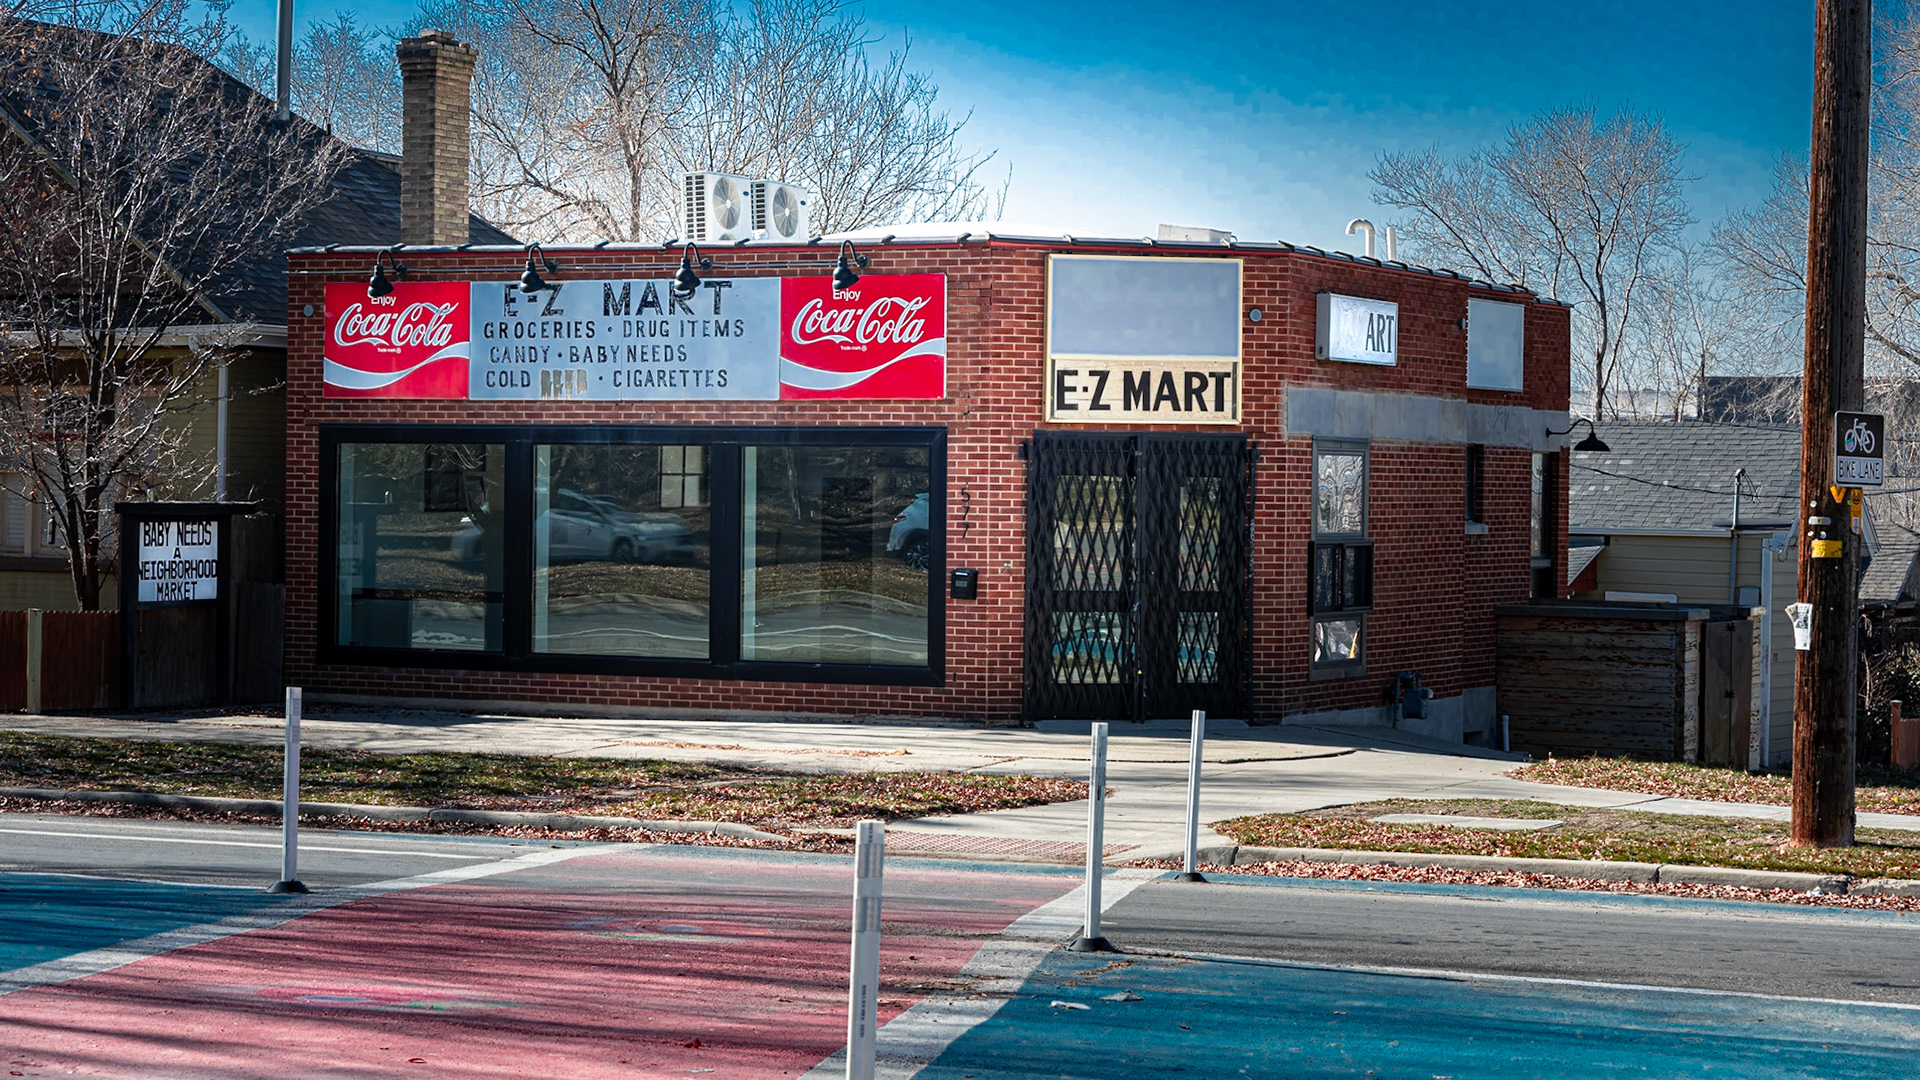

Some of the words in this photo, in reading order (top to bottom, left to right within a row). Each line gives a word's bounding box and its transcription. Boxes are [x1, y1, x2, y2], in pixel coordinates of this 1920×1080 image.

[371, 296, 396, 306] Enjoy
[603, 281, 732, 316] MART
[833, 288, 861, 301] Enjoy
[334, 302, 459, 346] Coca-Cola
[484, 321, 596, 339] GROCERIES
[623, 320, 670, 338] DRUG
[680, 319, 744, 338] ITEMS
[791, 296, 931, 344] Coca-Cola
[1365, 312, 1395, 353] ART
[490, 345, 550, 363] CANDY
[569, 345, 620, 363] BABY
[627, 344, 687, 363] NEEDS
[486, 370, 531, 388] COLD
[613, 369, 728, 388] CIGARETTES
[1123, 371, 1231, 412] MART
[1839, 460, 1856, 478] BIKE
[1859, 461, 1880, 479] LANE
[144, 521, 171, 546] BABY
[177, 521, 212, 546] NEEDS
[173, 547, 181, 559] A
[138, 559, 218, 580] NEIGHBORHOOD
[156, 581, 197, 601] MARKET
